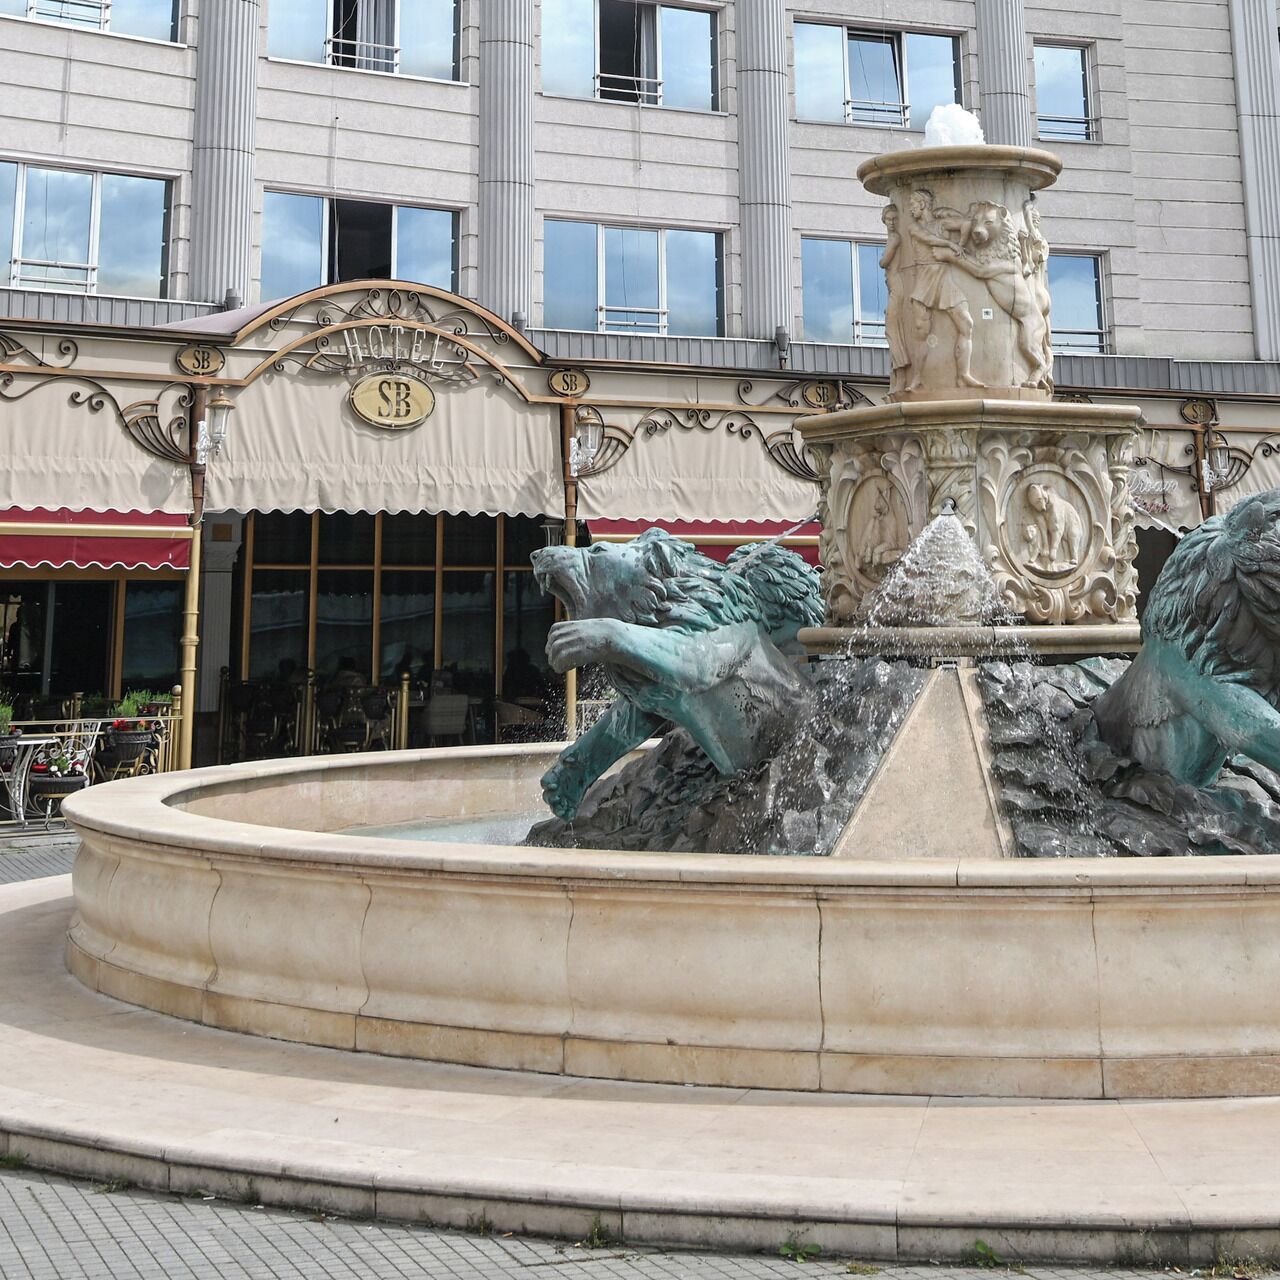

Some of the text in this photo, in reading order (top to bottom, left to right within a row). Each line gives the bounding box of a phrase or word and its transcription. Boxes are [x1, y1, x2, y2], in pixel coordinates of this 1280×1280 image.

[343, 324, 444, 370] HOTEL
[193, 350, 210, 369] SB
[562, 374, 577, 391] SB
[378, 380, 411, 418] SB
[815, 386, 829, 402] SB
